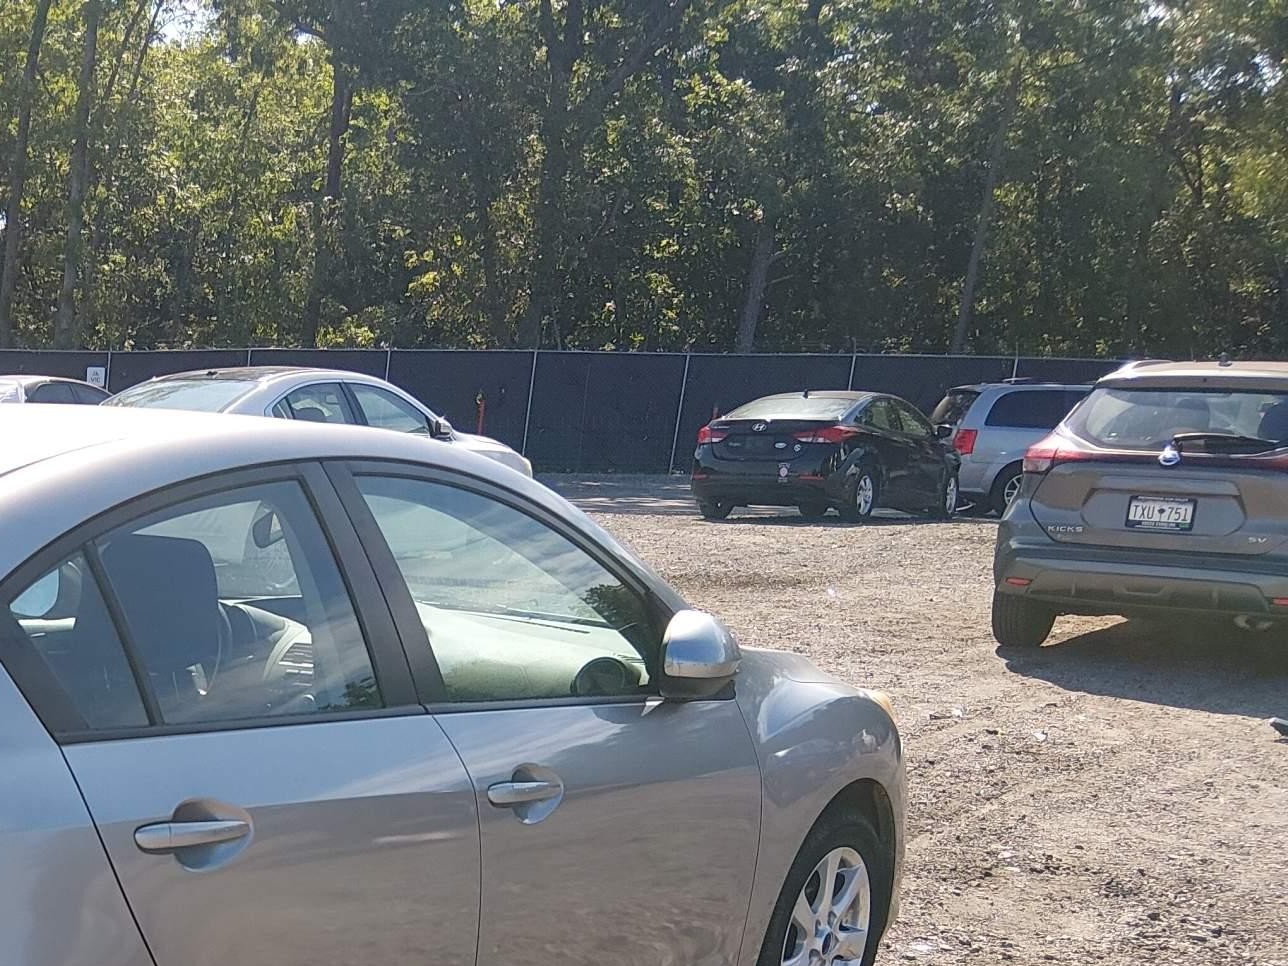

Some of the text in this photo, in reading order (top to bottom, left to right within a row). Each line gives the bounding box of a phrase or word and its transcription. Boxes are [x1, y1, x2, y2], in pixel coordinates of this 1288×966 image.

[1132, 504, 1189, 521] TXU 751
[1047, 525, 1084, 533] KICKS
